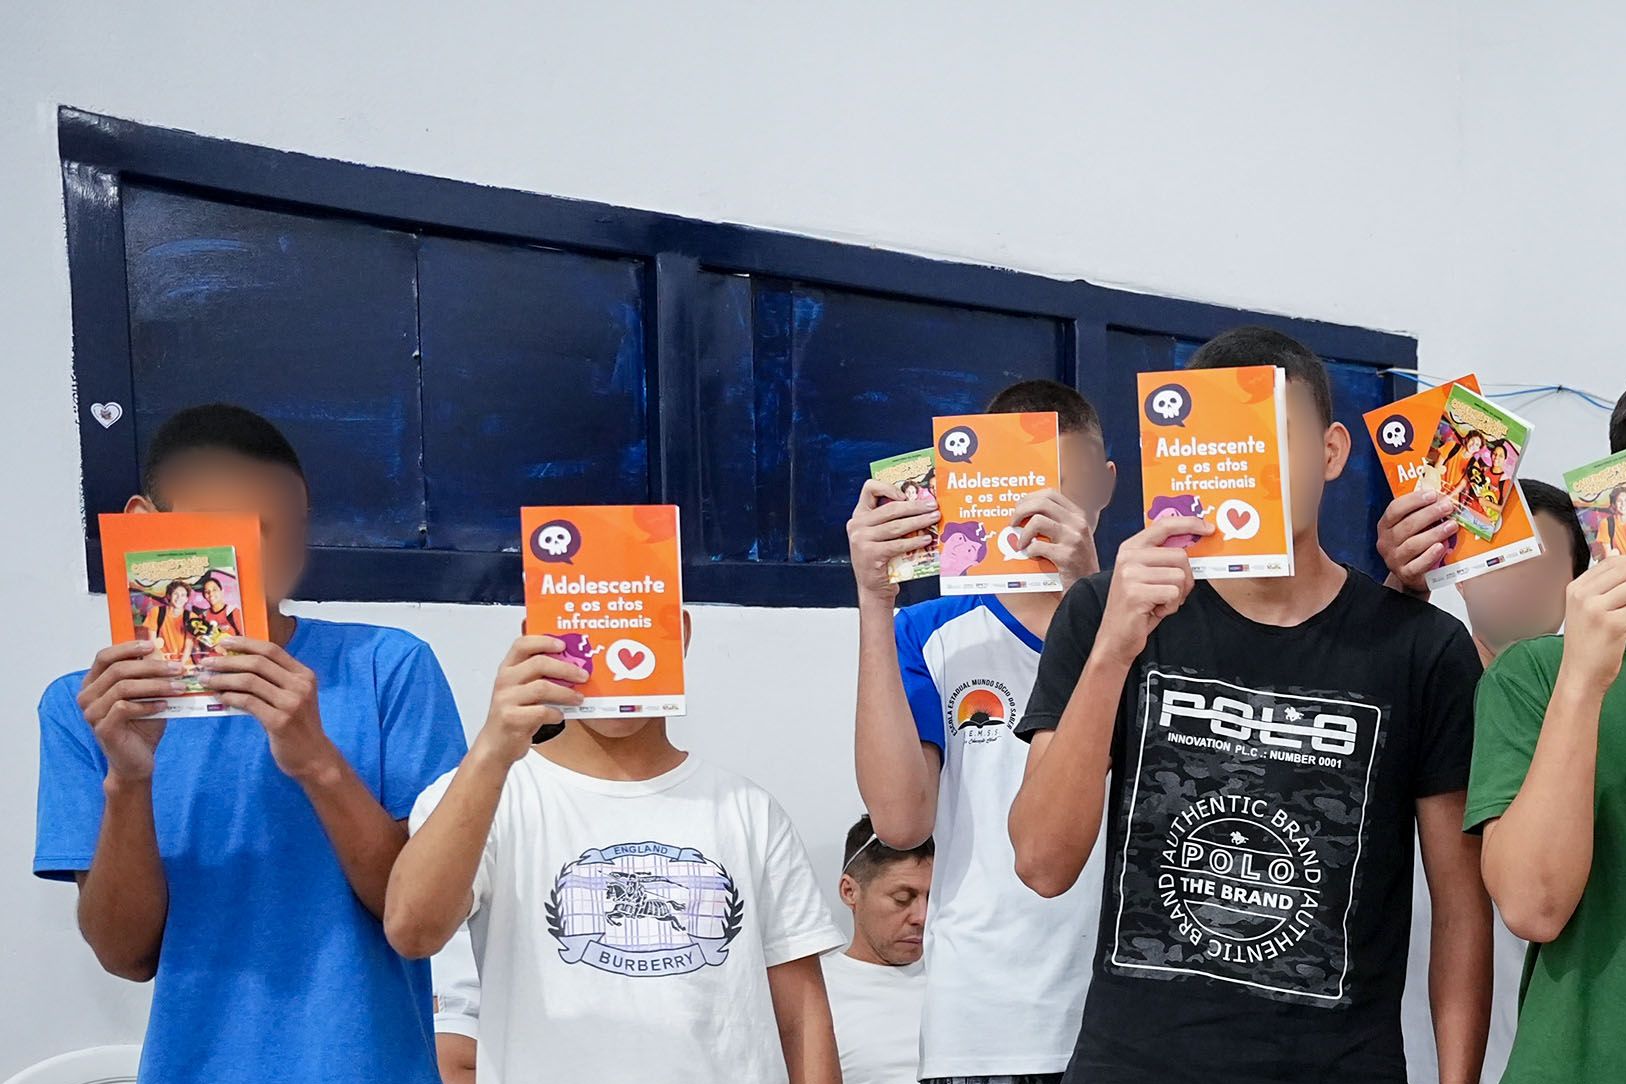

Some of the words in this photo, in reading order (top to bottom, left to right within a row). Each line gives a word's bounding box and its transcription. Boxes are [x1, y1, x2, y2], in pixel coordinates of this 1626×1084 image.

[1155, 436, 1266, 458] Adolescente
[1177, 464, 1186, 475] e
[1193, 463, 1211, 475] os
[1216, 458, 1248, 473] atos
[947, 471, 1045, 489] Adolescente
[1170, 474, 1256, 492] infracionais
[965, 494, 973, 503] e
[978, 493, 993, 502] os
[959, 504, 1016, 518] infracion
[540, 574, 665, 596] Adolescente
[564, 601, 575, 612] e
[582, 601, 600, 612] os
[607, 597, 643, 612] atos
[556, 613, 652, 630] infracionais
[972, 679, 995, 687] MUNDO
[994, 680, 1011, 697] SÓCIO
[948, 681, 971, 708] ESTADUAL
[1008, 697, 1016, 707] DO
[1006, 707, 1017, 730] SABER
[1159, 689, 1358, 756] POLO
[1168, 732, 1231, 753] INNOVATION
[1269, 749, 1317, 765] NUMBER
[1318, 755, 1342, 769] 0001
[615, 844, 668, 855] ENGLAND
[1161, 794, 1268, 864] AUTHENTIC
[1270, 809, 1322, 884] BRAND
[1181, 841, 1295, 886] POLO
[1180, 877, 1215, 897] THE
[1221, 886, 1294, 911] BRAND
[1159, 873, 1202, 945] BRAND
[1207, 893, 1319, 964] AUTHENTIC
[599, 951, 694, 972] BURBERRY
